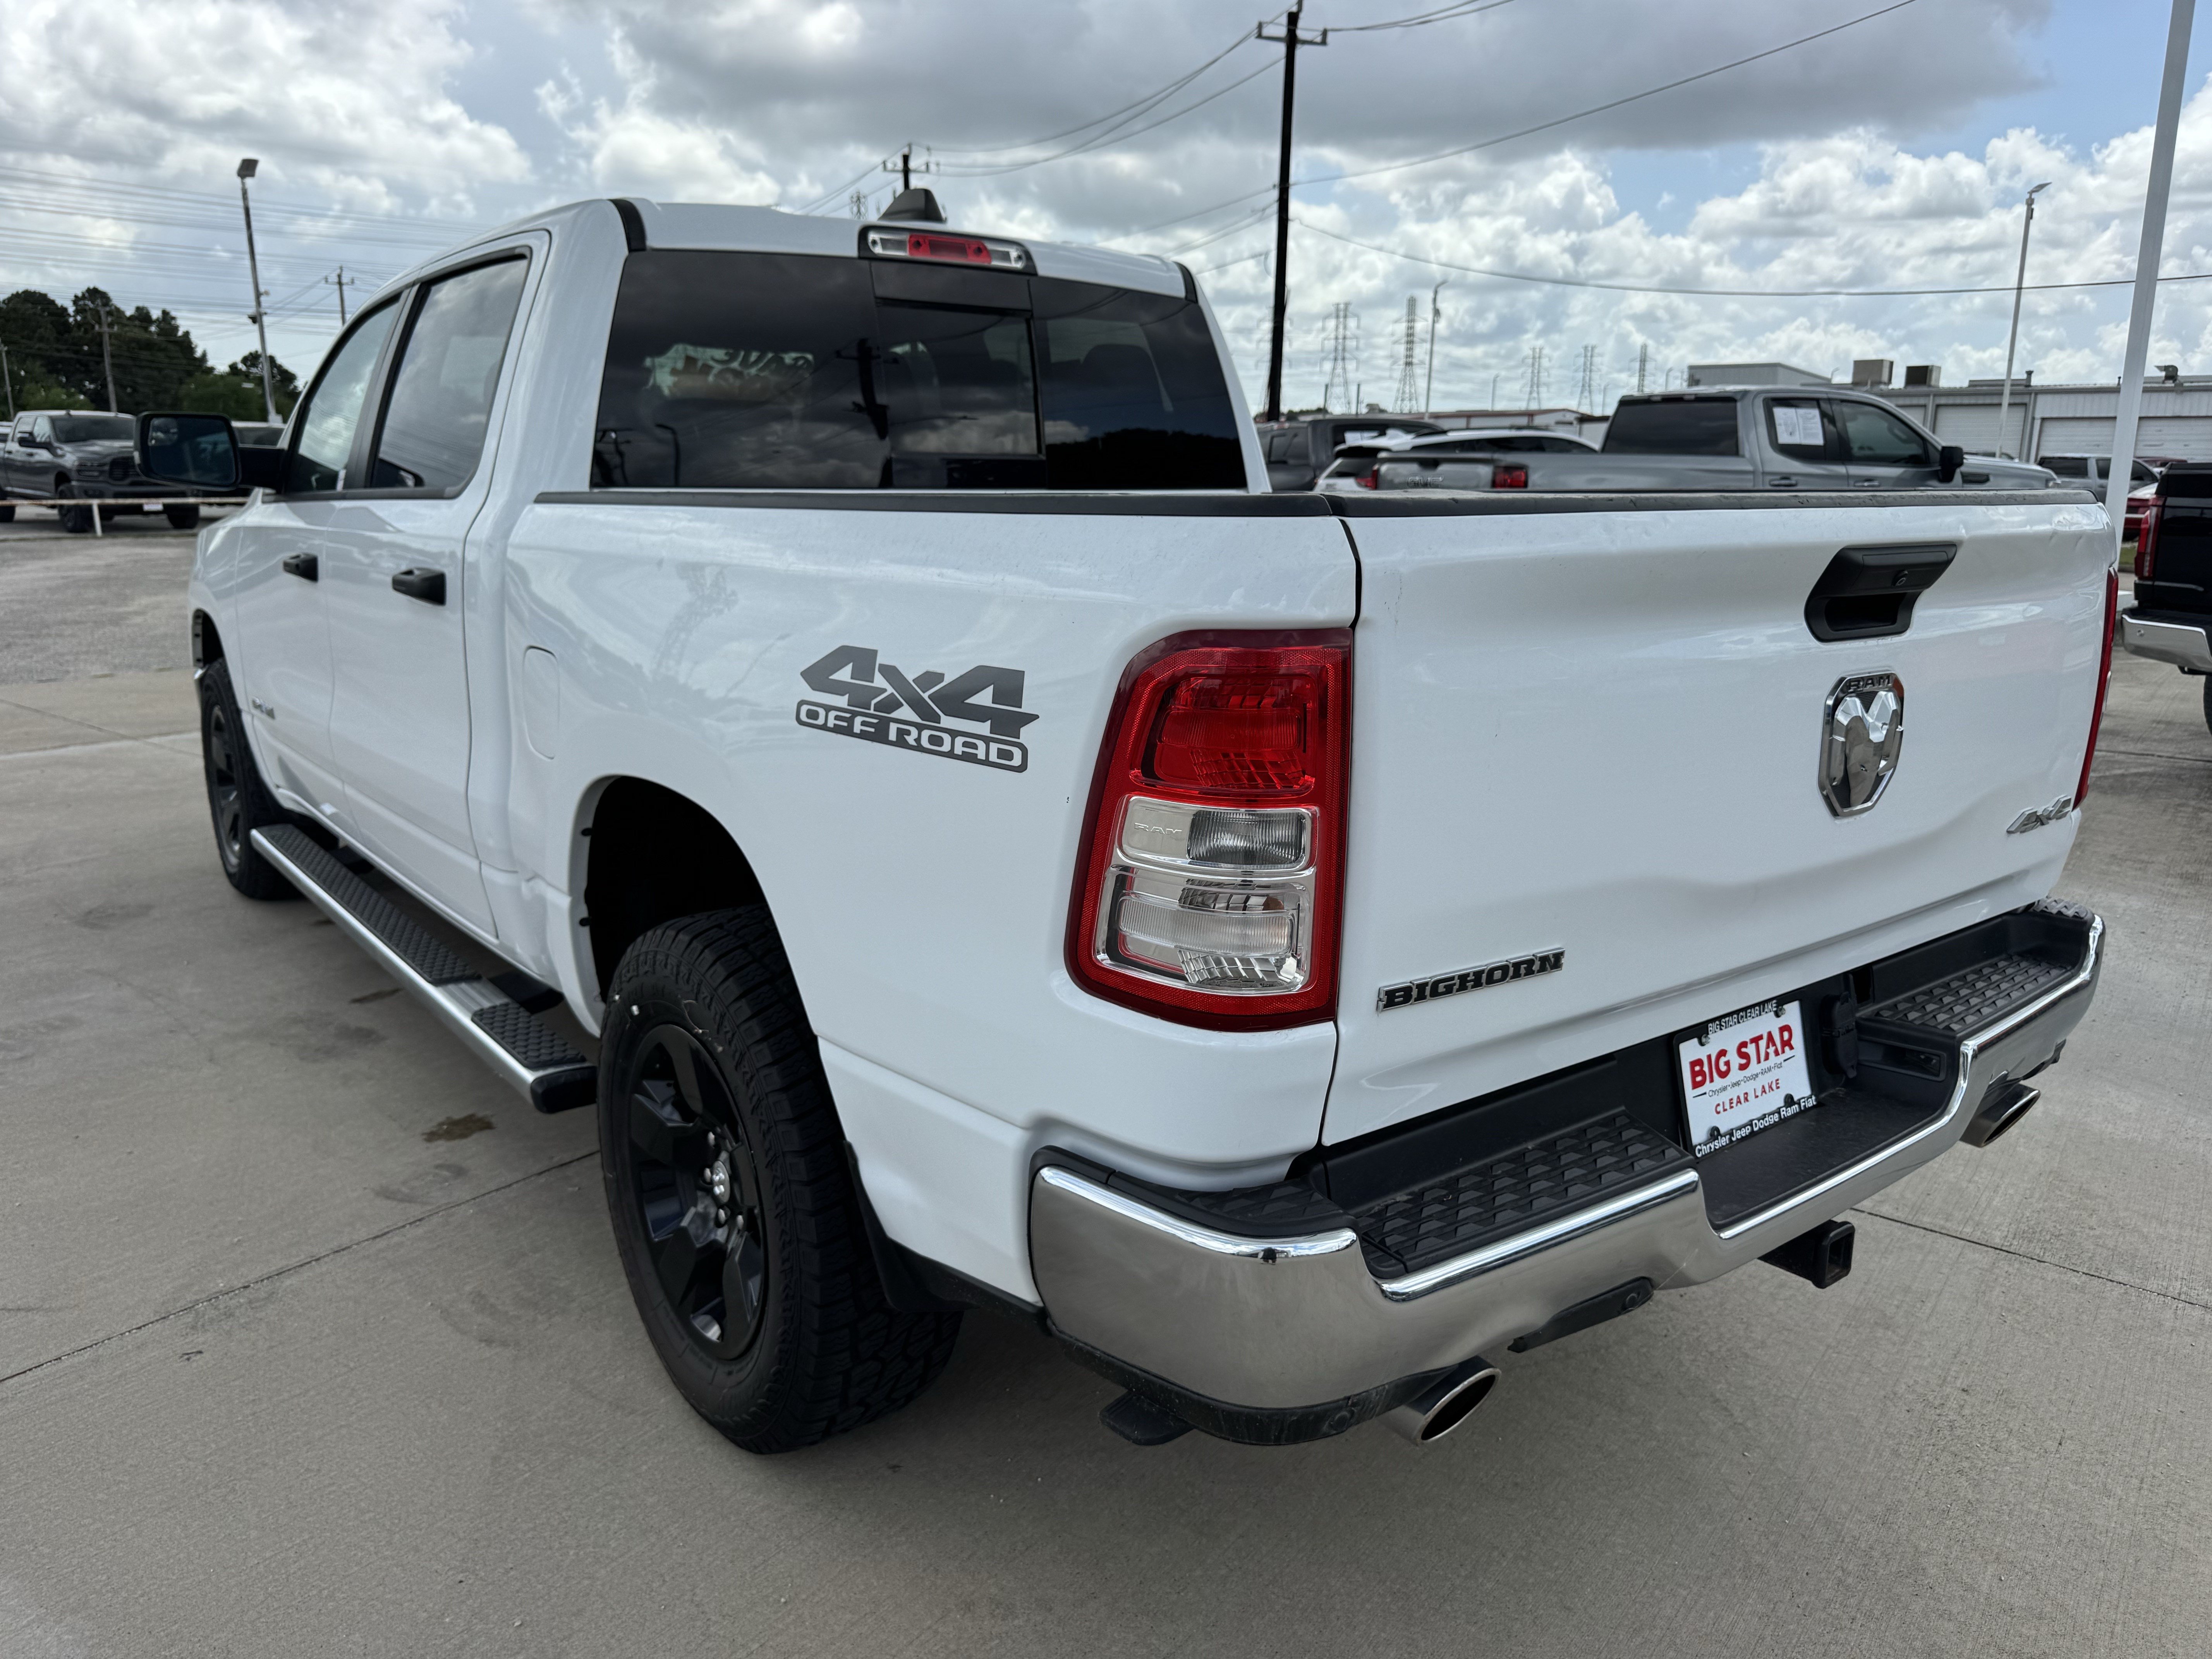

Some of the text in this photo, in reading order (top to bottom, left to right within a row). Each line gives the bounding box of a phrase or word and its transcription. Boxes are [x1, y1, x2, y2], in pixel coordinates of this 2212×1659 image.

[1846, 675, 1893, 692] RAM
[799, 704, 1022, 767] OFF ROAD
[1377, 947, 1565, 1013] BIGHORN
[1708, 1000, 1778, 1034] BIG STAR CLEAR LAKE
[1689, 1024, 1795, 1090] BIG STAR
[1695, 1095, 1817, 1158] Chrysler Jeep Dodge Ram Fiat
[1715, 1079, 1780, 1115] CLEAR LAKE
